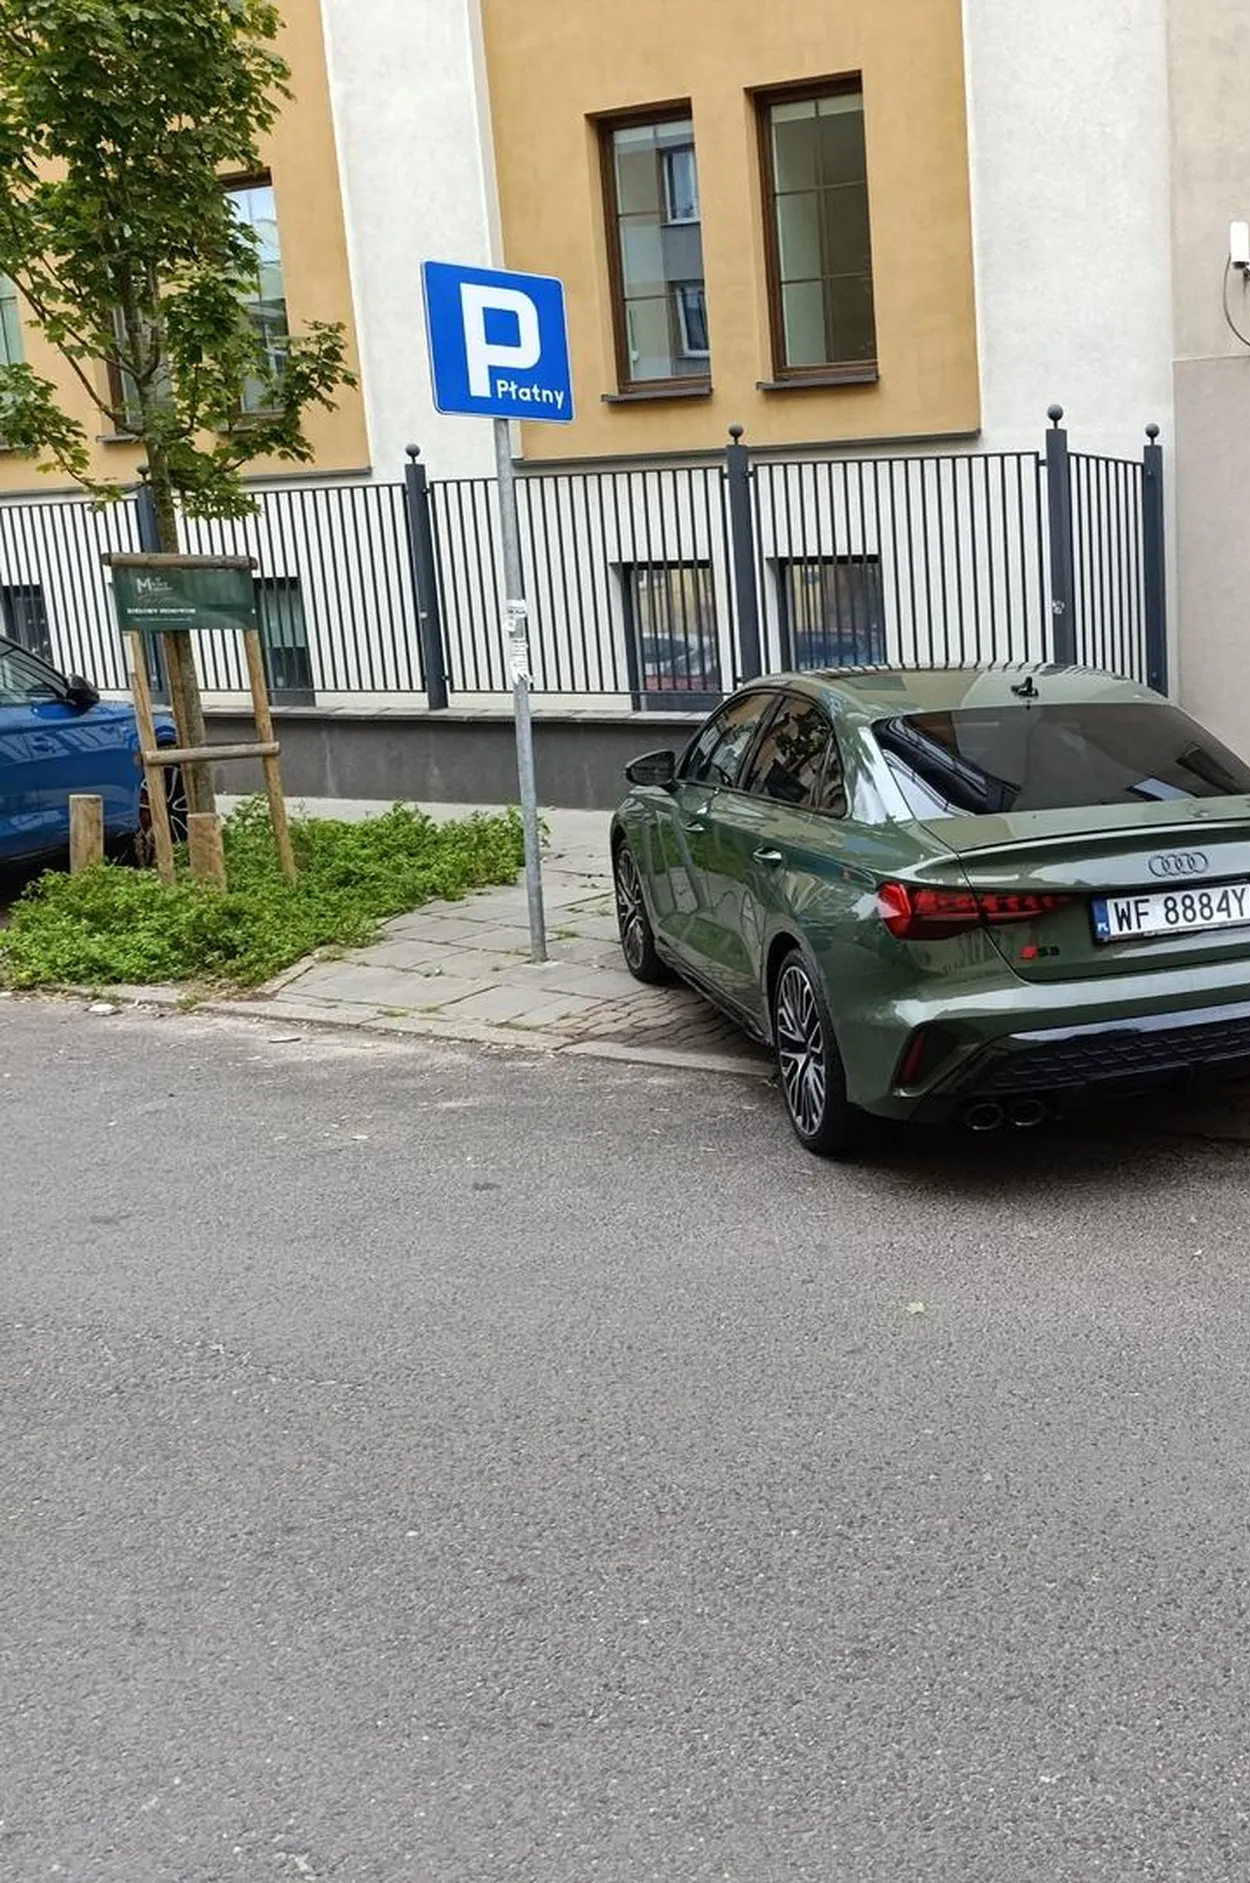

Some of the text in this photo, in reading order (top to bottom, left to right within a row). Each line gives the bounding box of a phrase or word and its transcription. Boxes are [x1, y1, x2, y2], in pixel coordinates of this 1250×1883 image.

[460, 282, 541, 398] P
[496, 379, 565, 410] Płatny
[1114, 898, 1150, 932] WF
[1163, 887, 1246, 925] 8884Y
